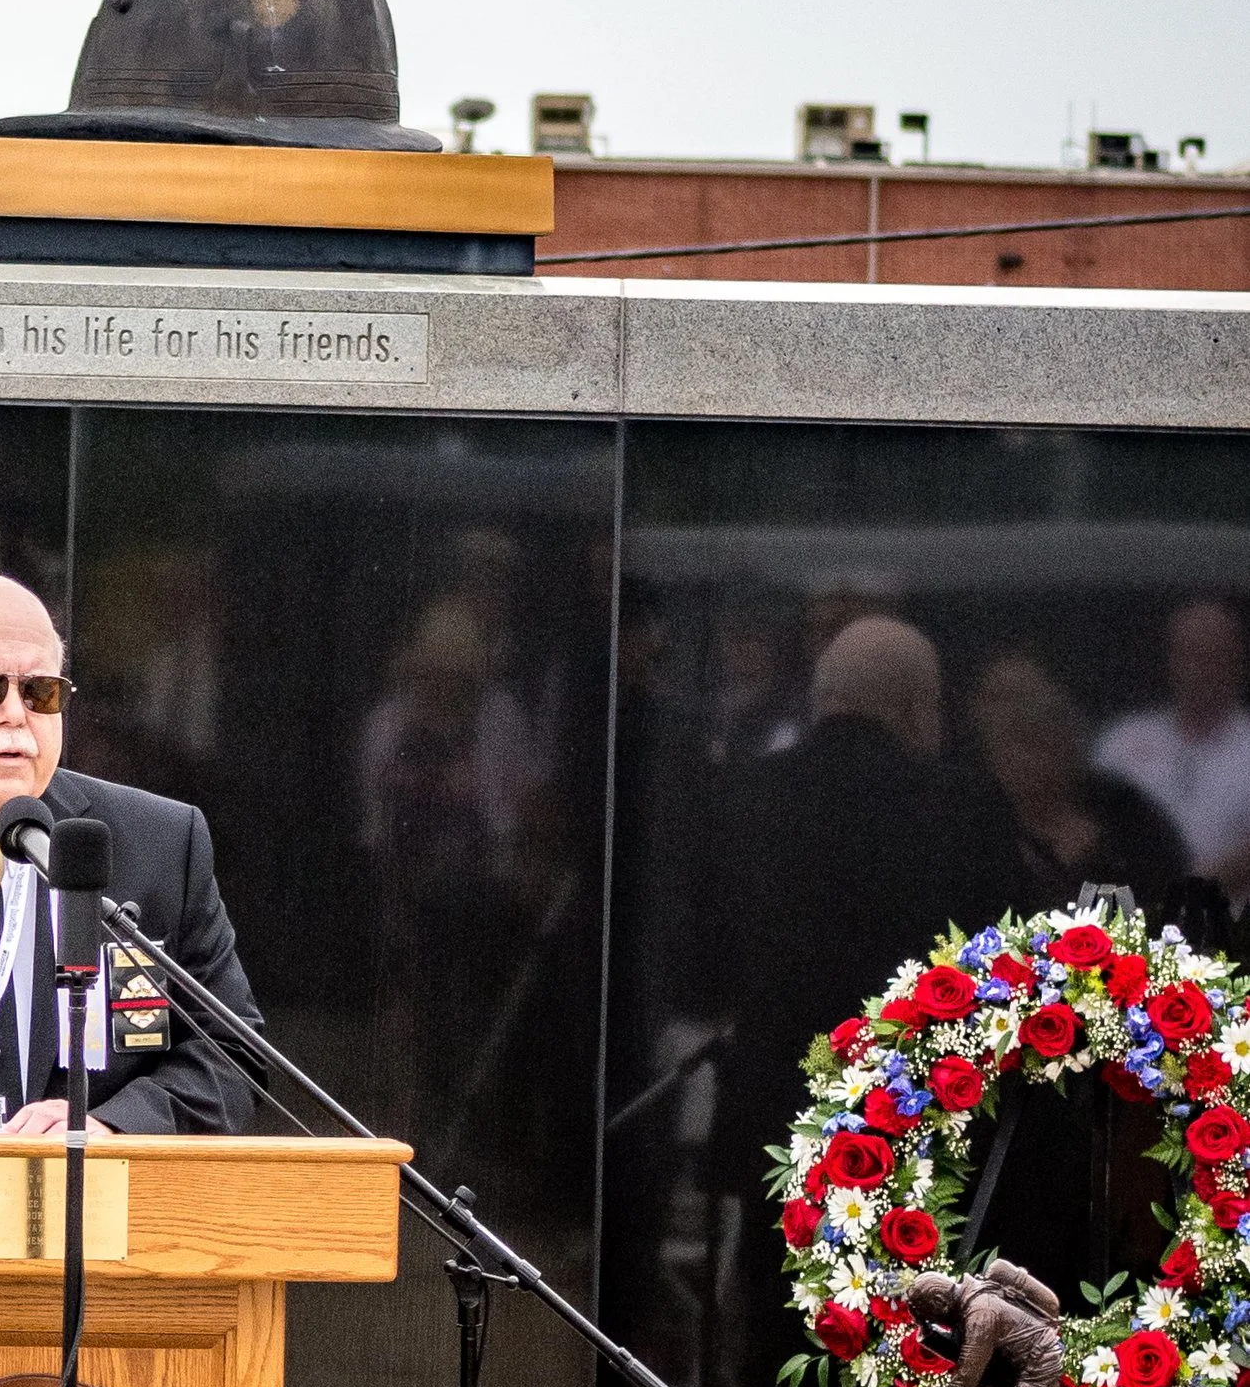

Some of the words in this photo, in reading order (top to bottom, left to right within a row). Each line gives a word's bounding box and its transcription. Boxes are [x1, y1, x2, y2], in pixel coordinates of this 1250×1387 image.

[23, 315, 66, 356] his
[84, 316, 134, 358] life
[152, 317, 198, 359] for
[216, 319, 260, 360] his
[277, 320, 399, 364] friends.
